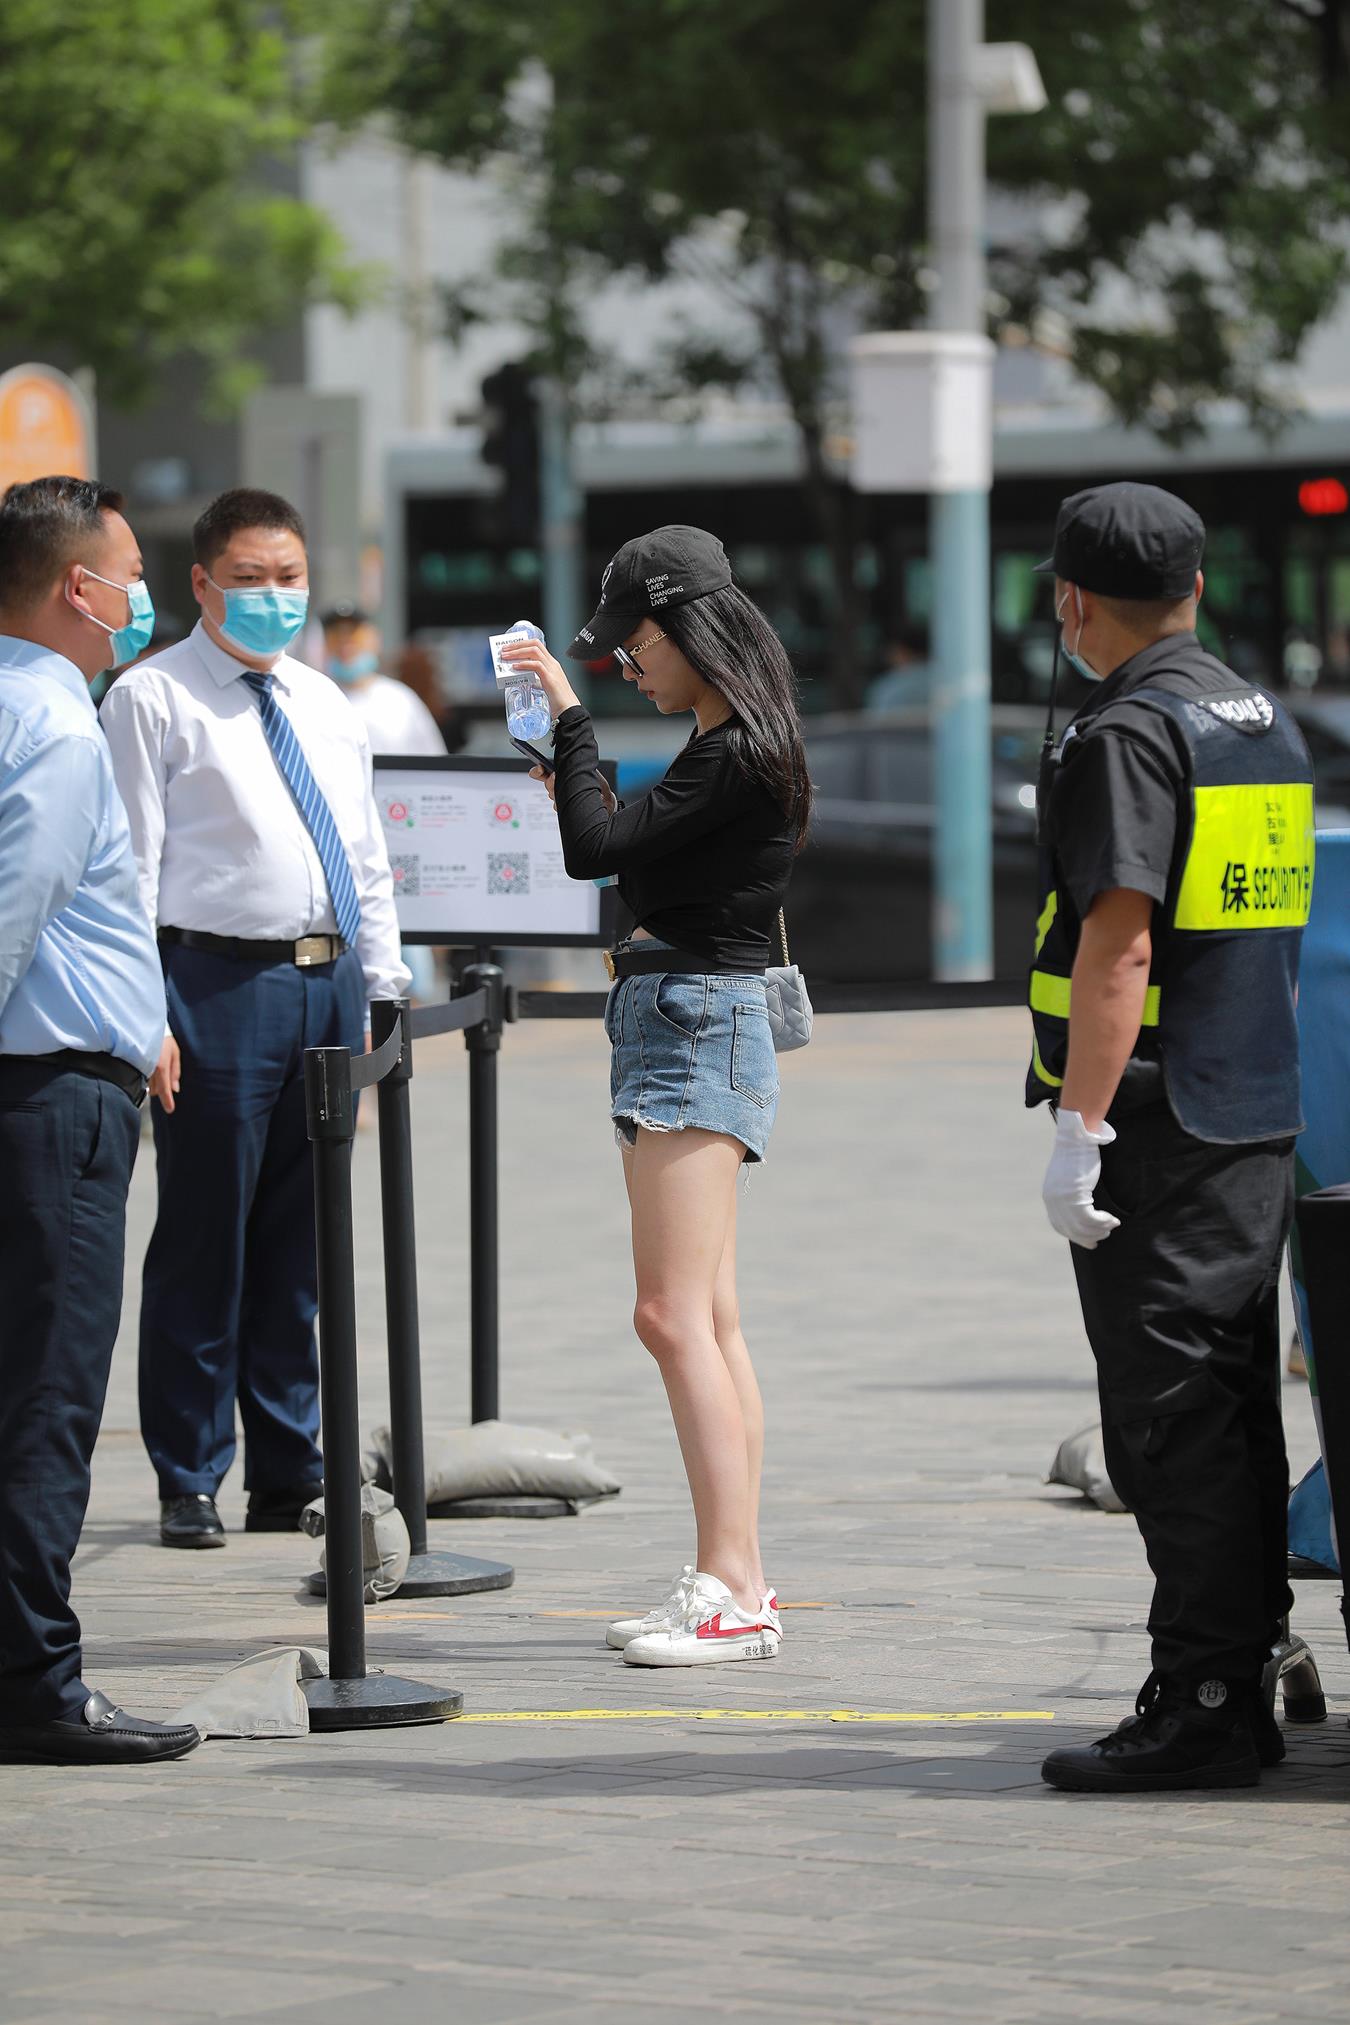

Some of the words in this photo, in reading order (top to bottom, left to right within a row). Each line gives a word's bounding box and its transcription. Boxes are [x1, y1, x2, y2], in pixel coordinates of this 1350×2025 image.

[645, 573, 670, 586] SAVING
[647, 582, 665, 593] LIVES
[649, 585, 685, 600] CHANGING
[651, 596, 669, 607] LIVES
[633, 630, 668, 655] CHANEL
[1220, 861, 1250, 914] 保
[1253, 866, 1304, 911] SECURITY
